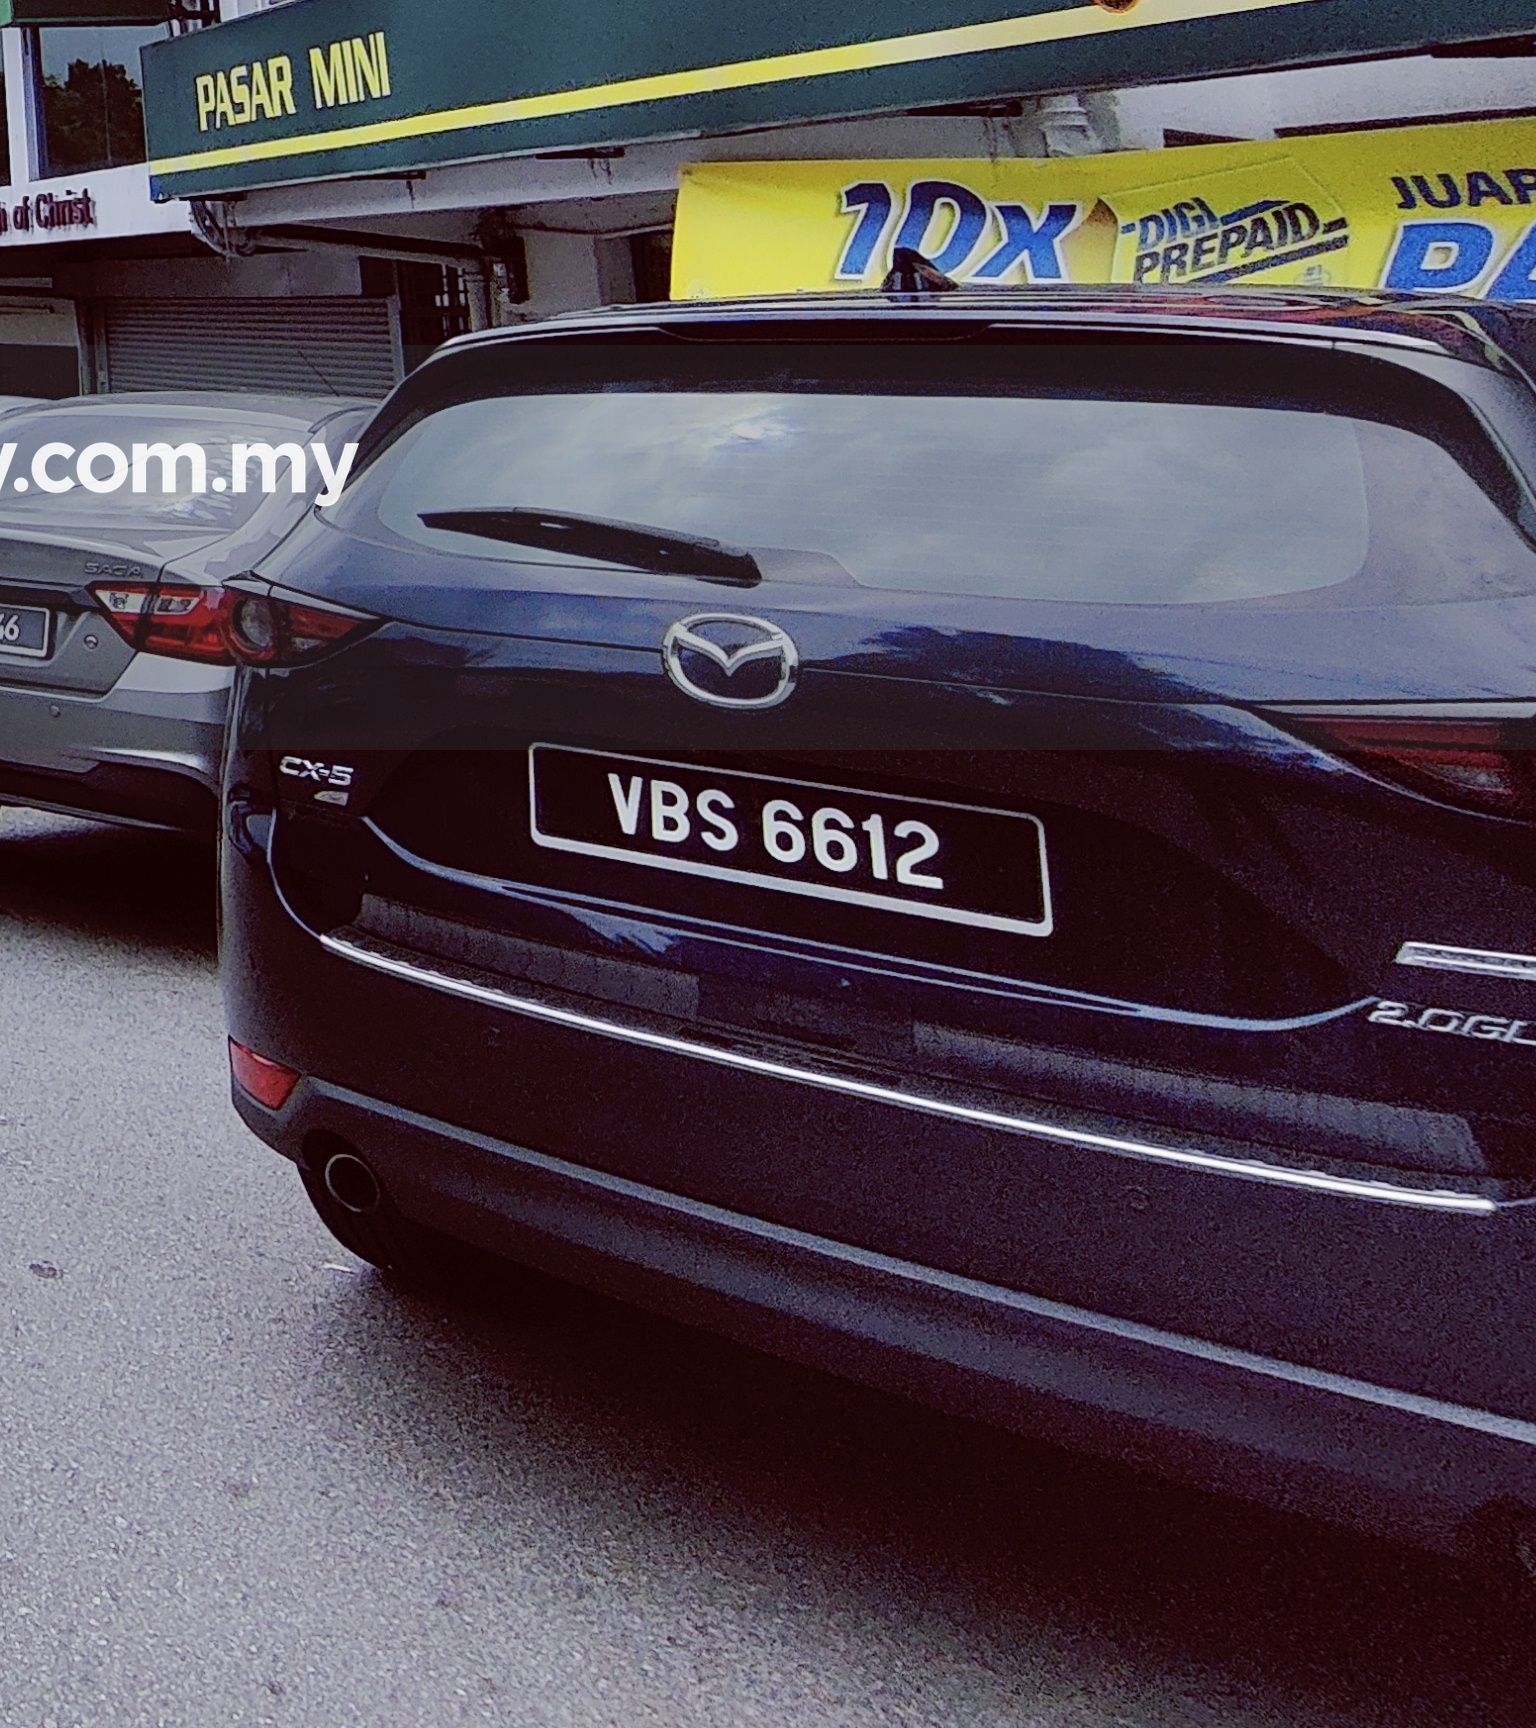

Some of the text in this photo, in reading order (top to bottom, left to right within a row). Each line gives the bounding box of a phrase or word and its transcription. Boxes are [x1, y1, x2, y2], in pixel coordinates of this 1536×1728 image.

[195, 31, 392, 132] PASAR MINI
[13, 196, 30, 230] of
[35, 188, 94, 229] Christ
[1135, 196, 1221, 251] DIGI
[1133, 201, 1321, 285] PREPAID
[84, 561, 144, 578] SAGA
[279, 755, 354, 786] CX-5
[607, 772, 944, 890] VBS 6612
